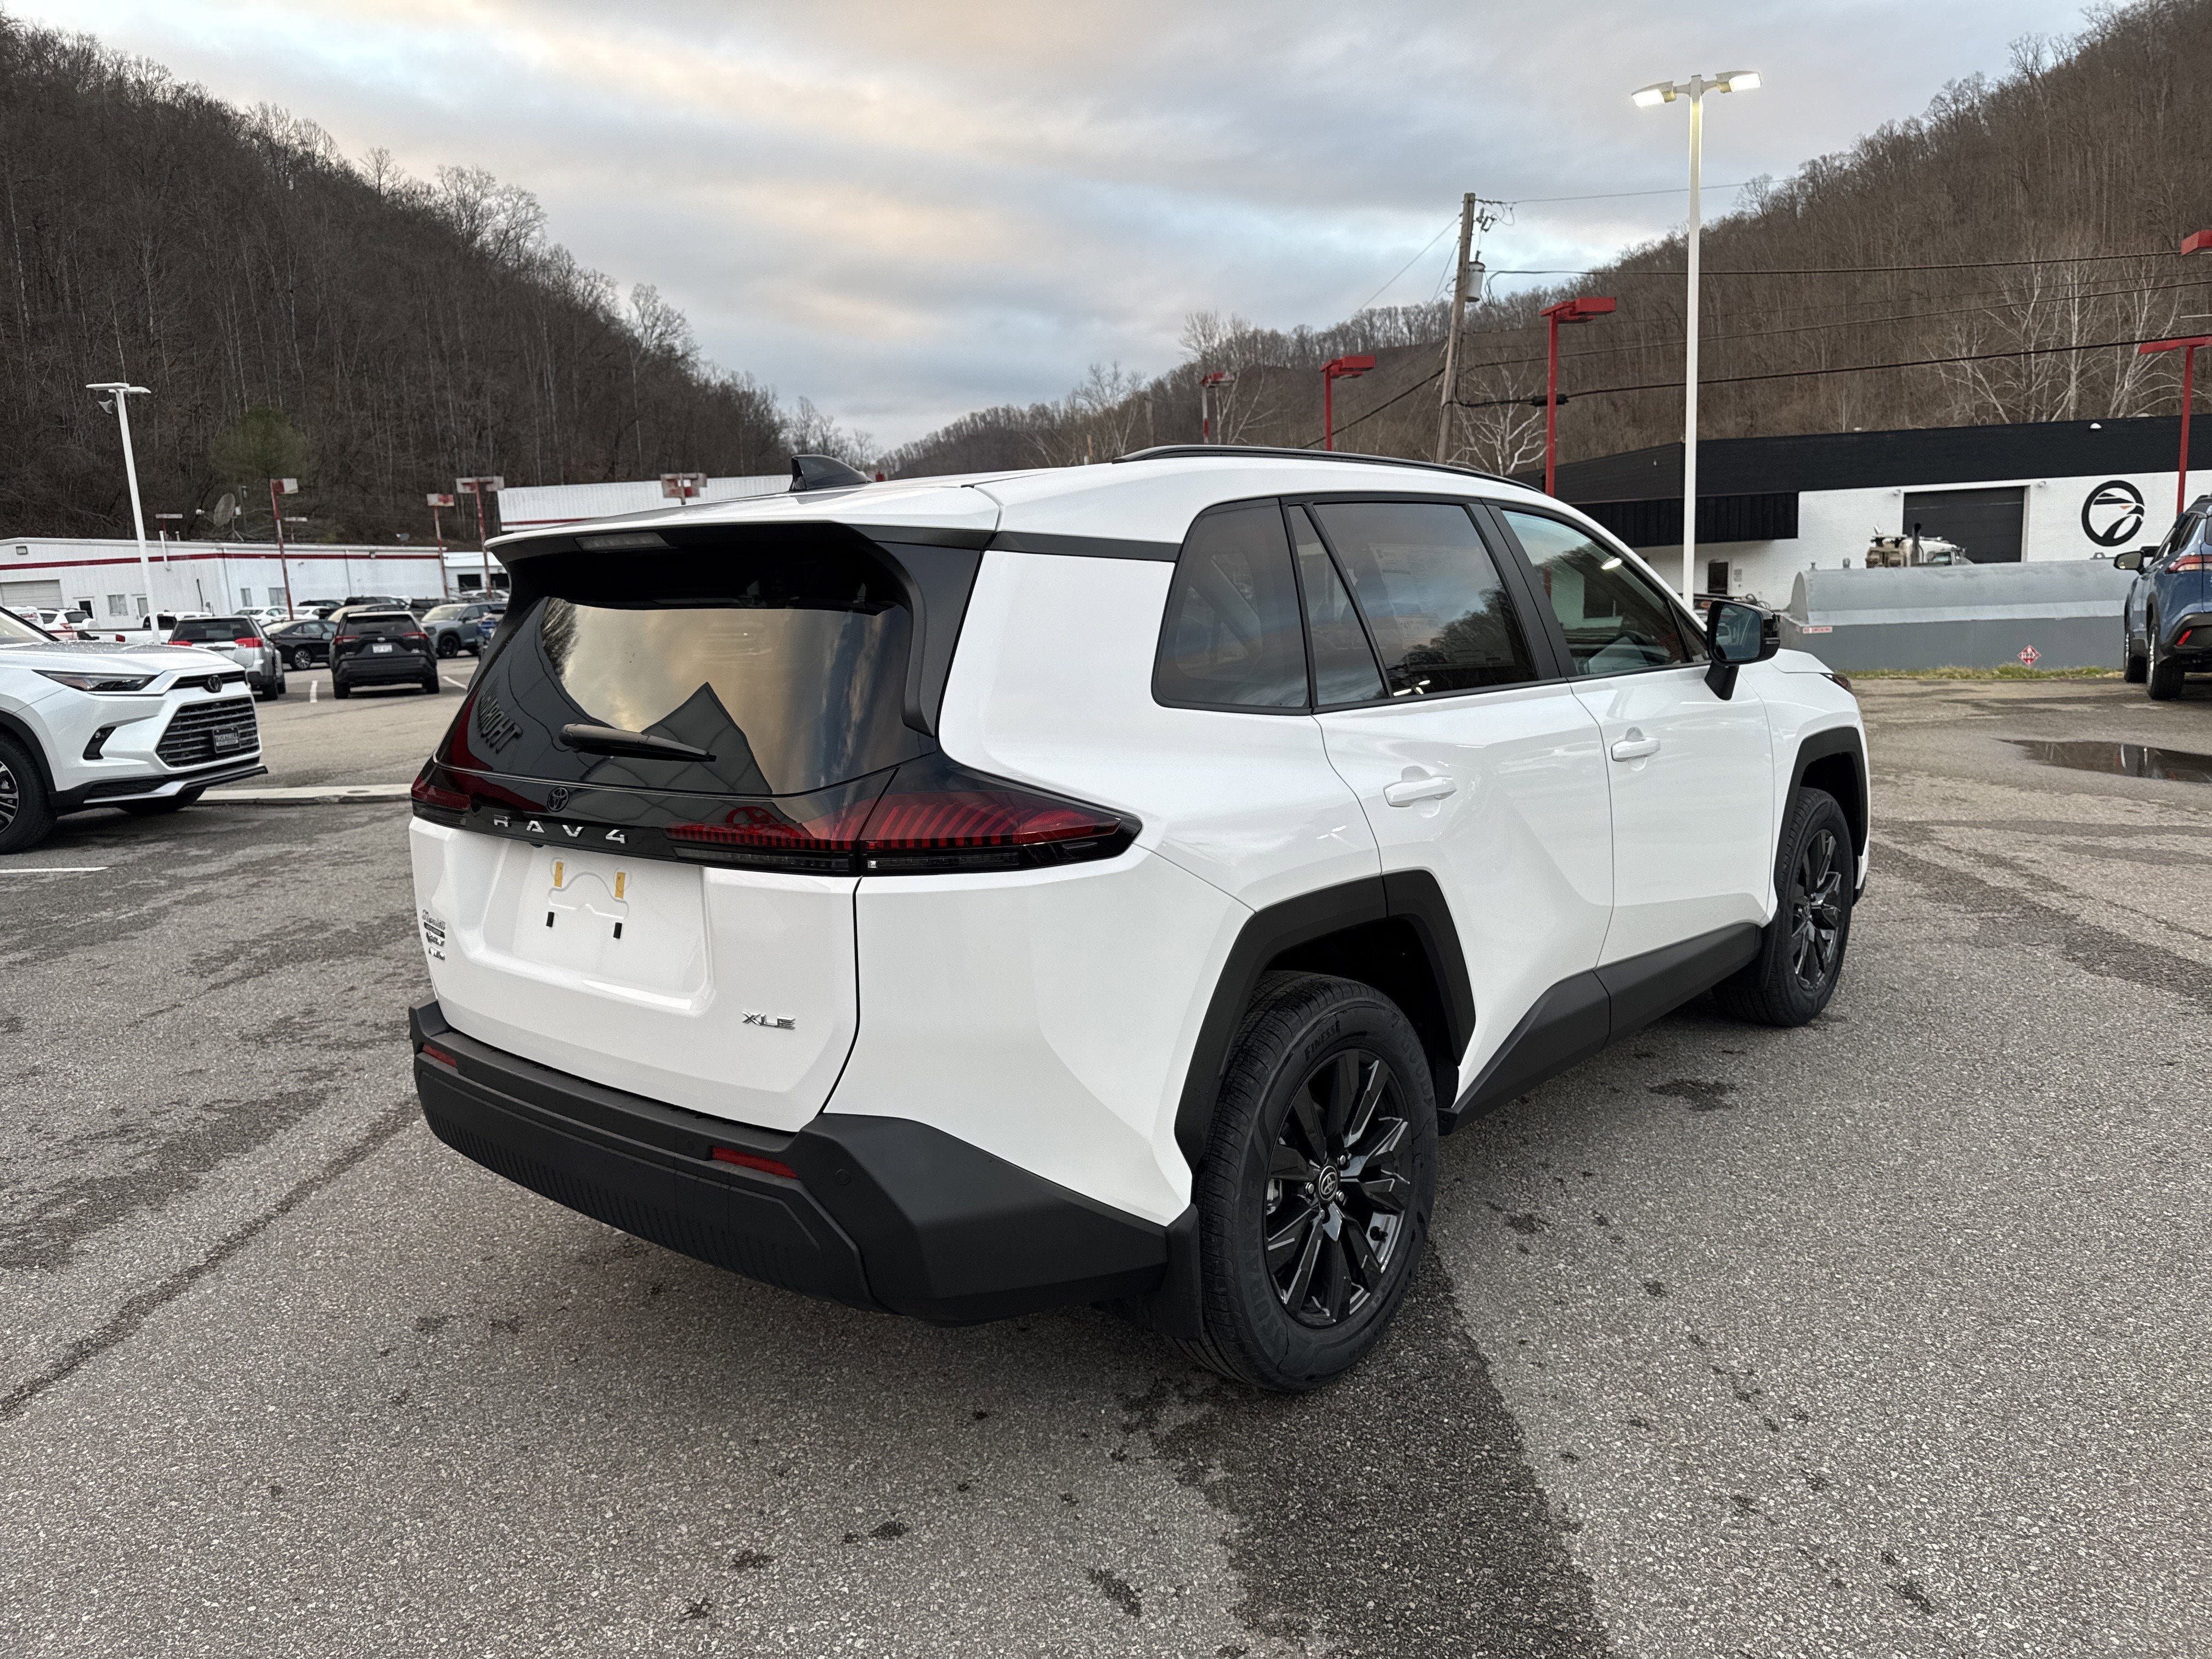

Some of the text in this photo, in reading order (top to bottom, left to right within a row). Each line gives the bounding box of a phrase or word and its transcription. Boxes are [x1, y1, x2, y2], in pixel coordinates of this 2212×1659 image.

[493, 815, 629, 844] RAV4
[742, 1010, 795, 1030] XLE
[1304, 1019, 1341, 1062] FINESSE
